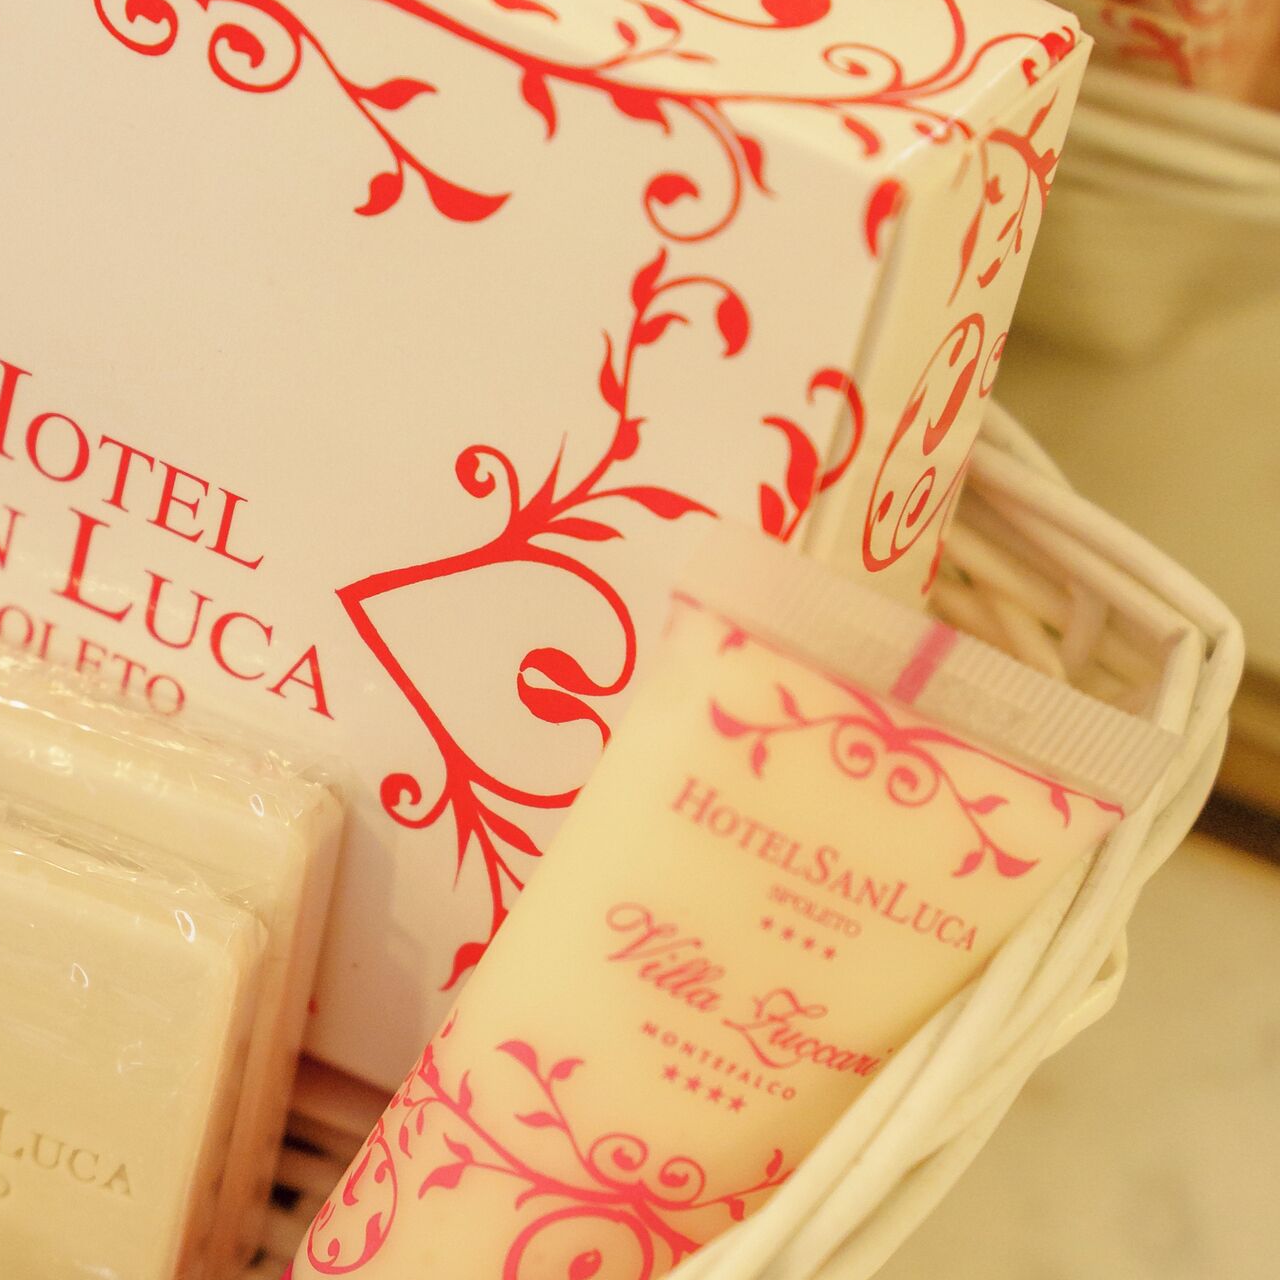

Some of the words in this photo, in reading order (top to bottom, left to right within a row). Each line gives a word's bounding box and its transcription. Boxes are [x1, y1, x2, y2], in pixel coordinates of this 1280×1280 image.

[52, 507, 335, 721] LUCA
[605, 902, 725, 1013] Villa
[641, 1021, 797, 1101] MONTEFALCO
